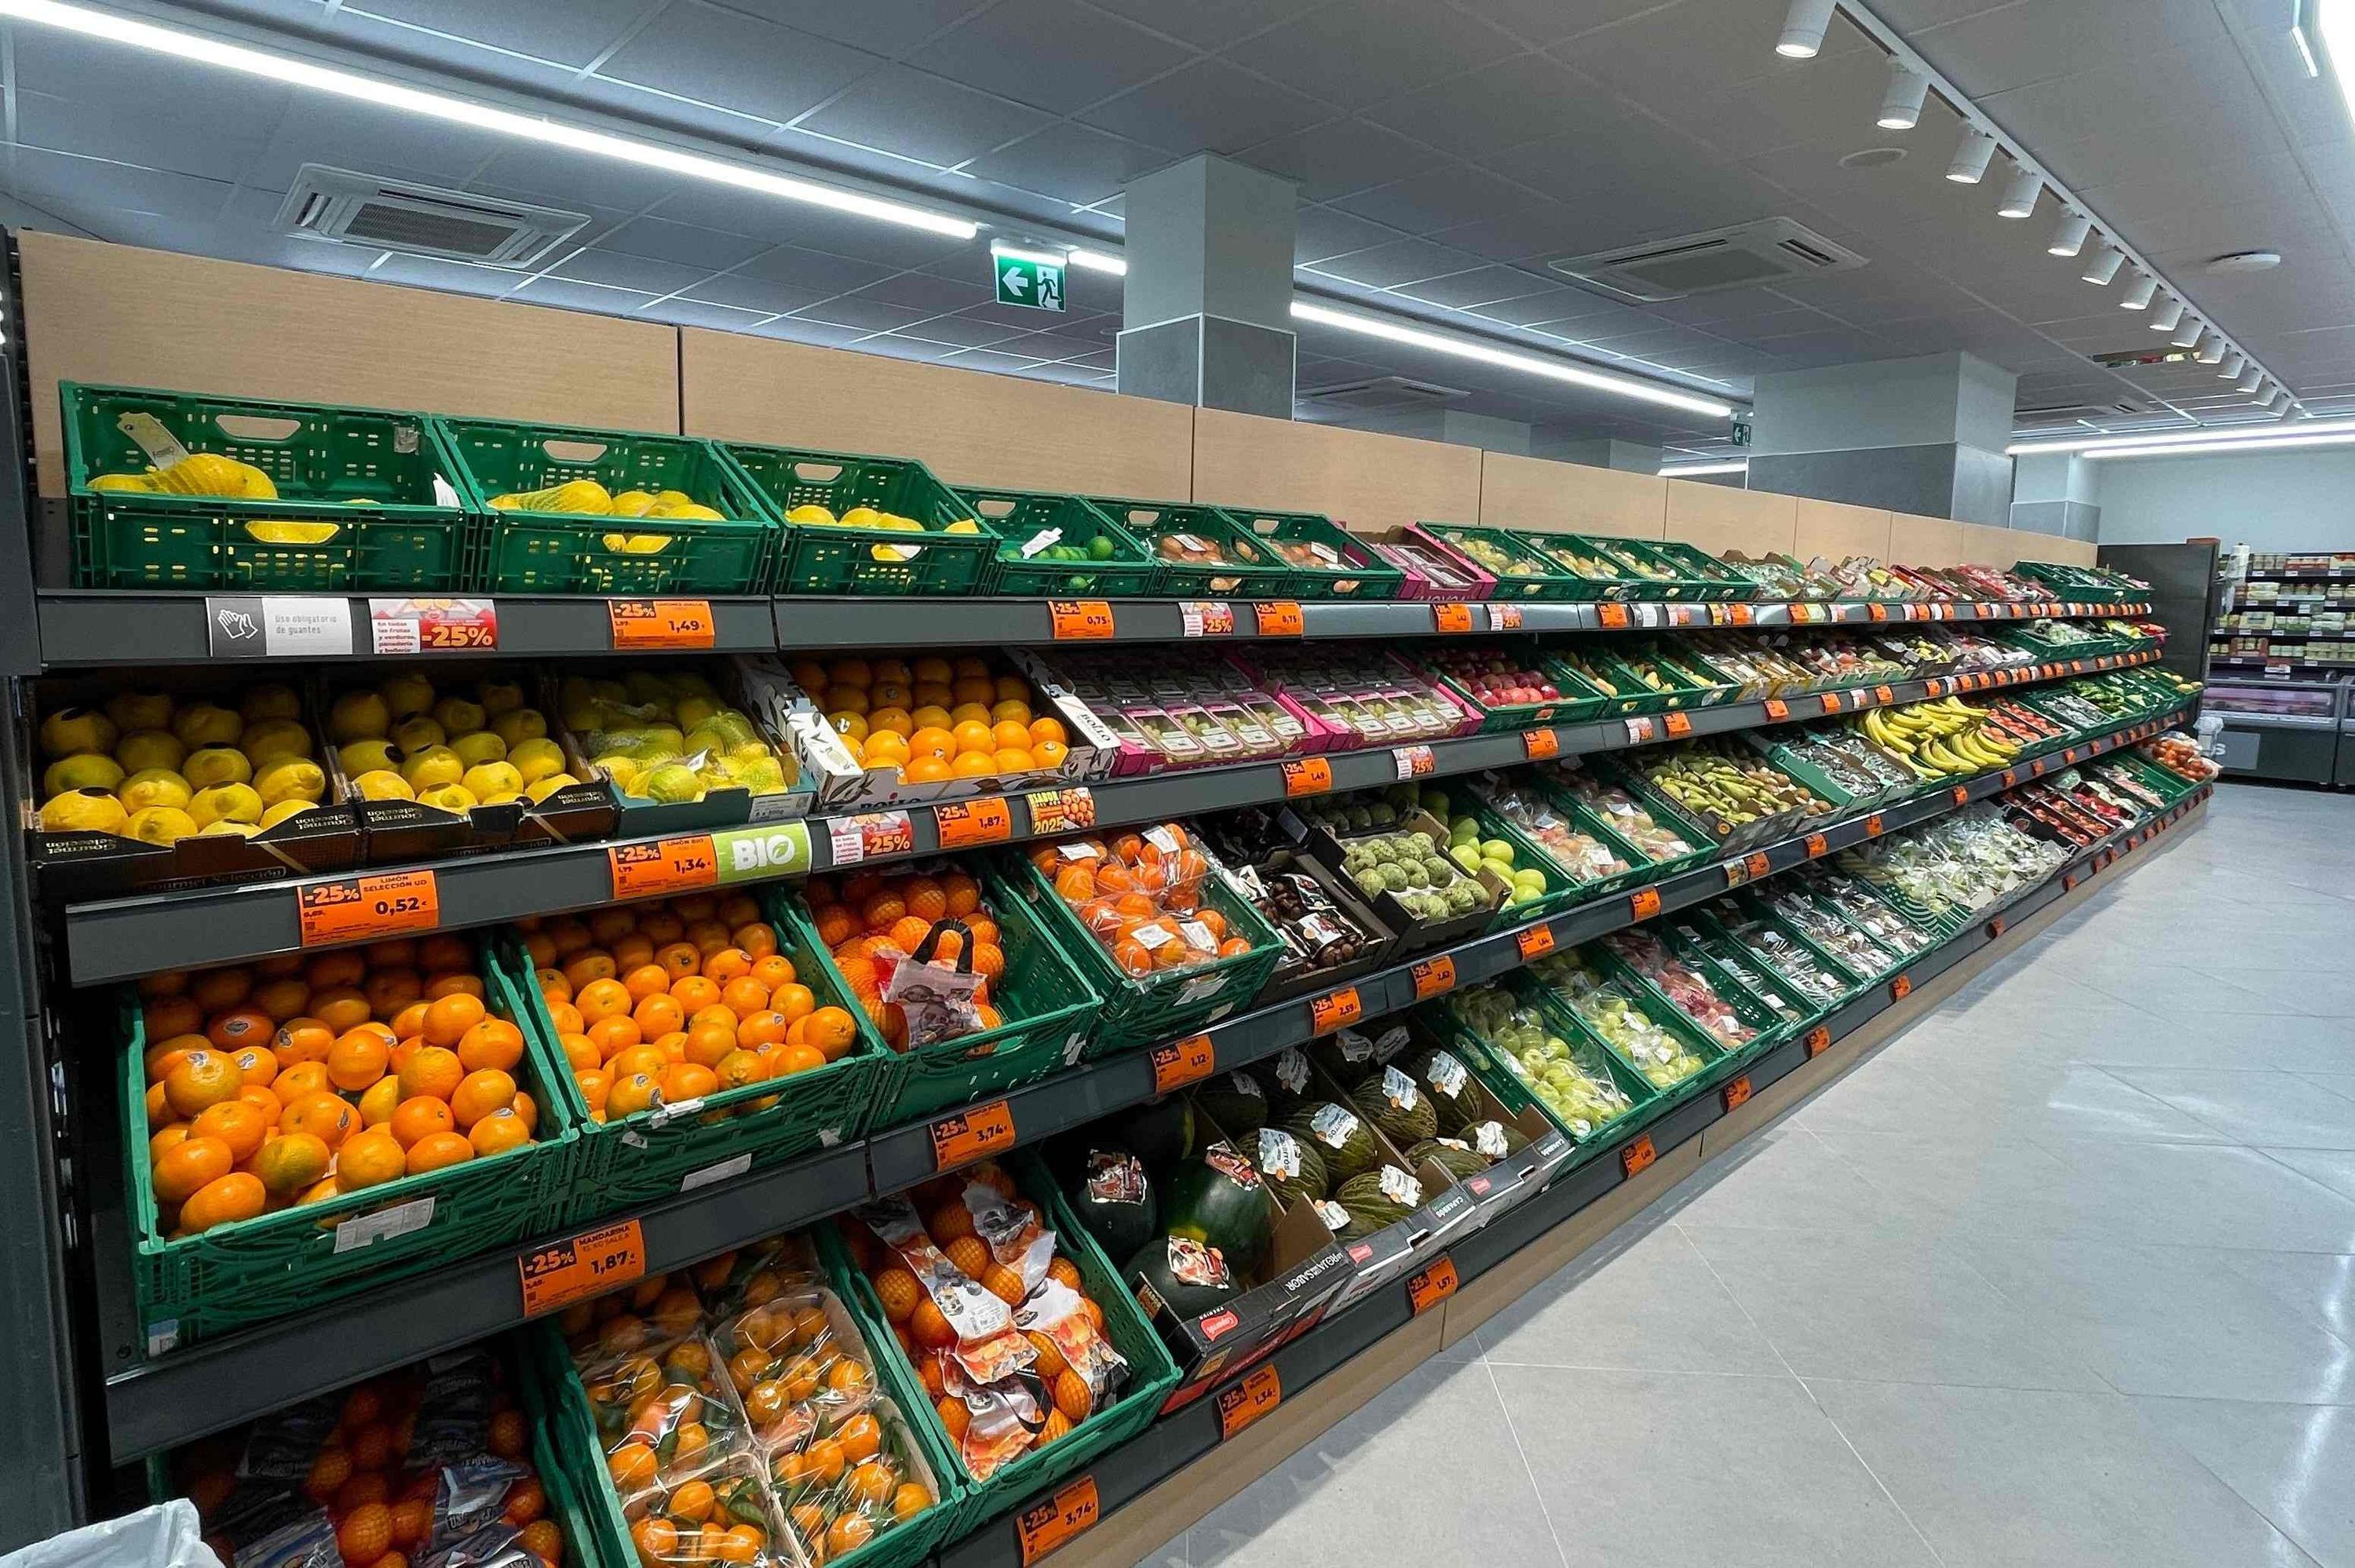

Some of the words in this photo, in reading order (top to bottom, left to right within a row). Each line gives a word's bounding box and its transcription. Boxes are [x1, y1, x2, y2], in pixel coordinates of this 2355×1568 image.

[292, 614, 337, 624] obligatorio
[614, 603, 655, 618] -25%
[288, 626, 321, 636] guantes
[1203, 618, 1232, 633] -25%
[422, 625, 493, 647] -25%
[940, 805, 968, 819] -25%
[1034, 816, 1064, 835] 2025
[617, 846, 659, 861] -25%
[732, 833, 795, 870] BIO
[864, 835, 911, 855] -25%
[305, 885, 360, 904] -25%
[936, 1120, 968, 1138] -25%
[525, 1250, 574, 1273] -25%
[579, 1225, 630, 1245] MANDARINA
[1318, 1253, 1339, 1270] ROJA
[1285, 1269, 1316, 1291] SABOR
